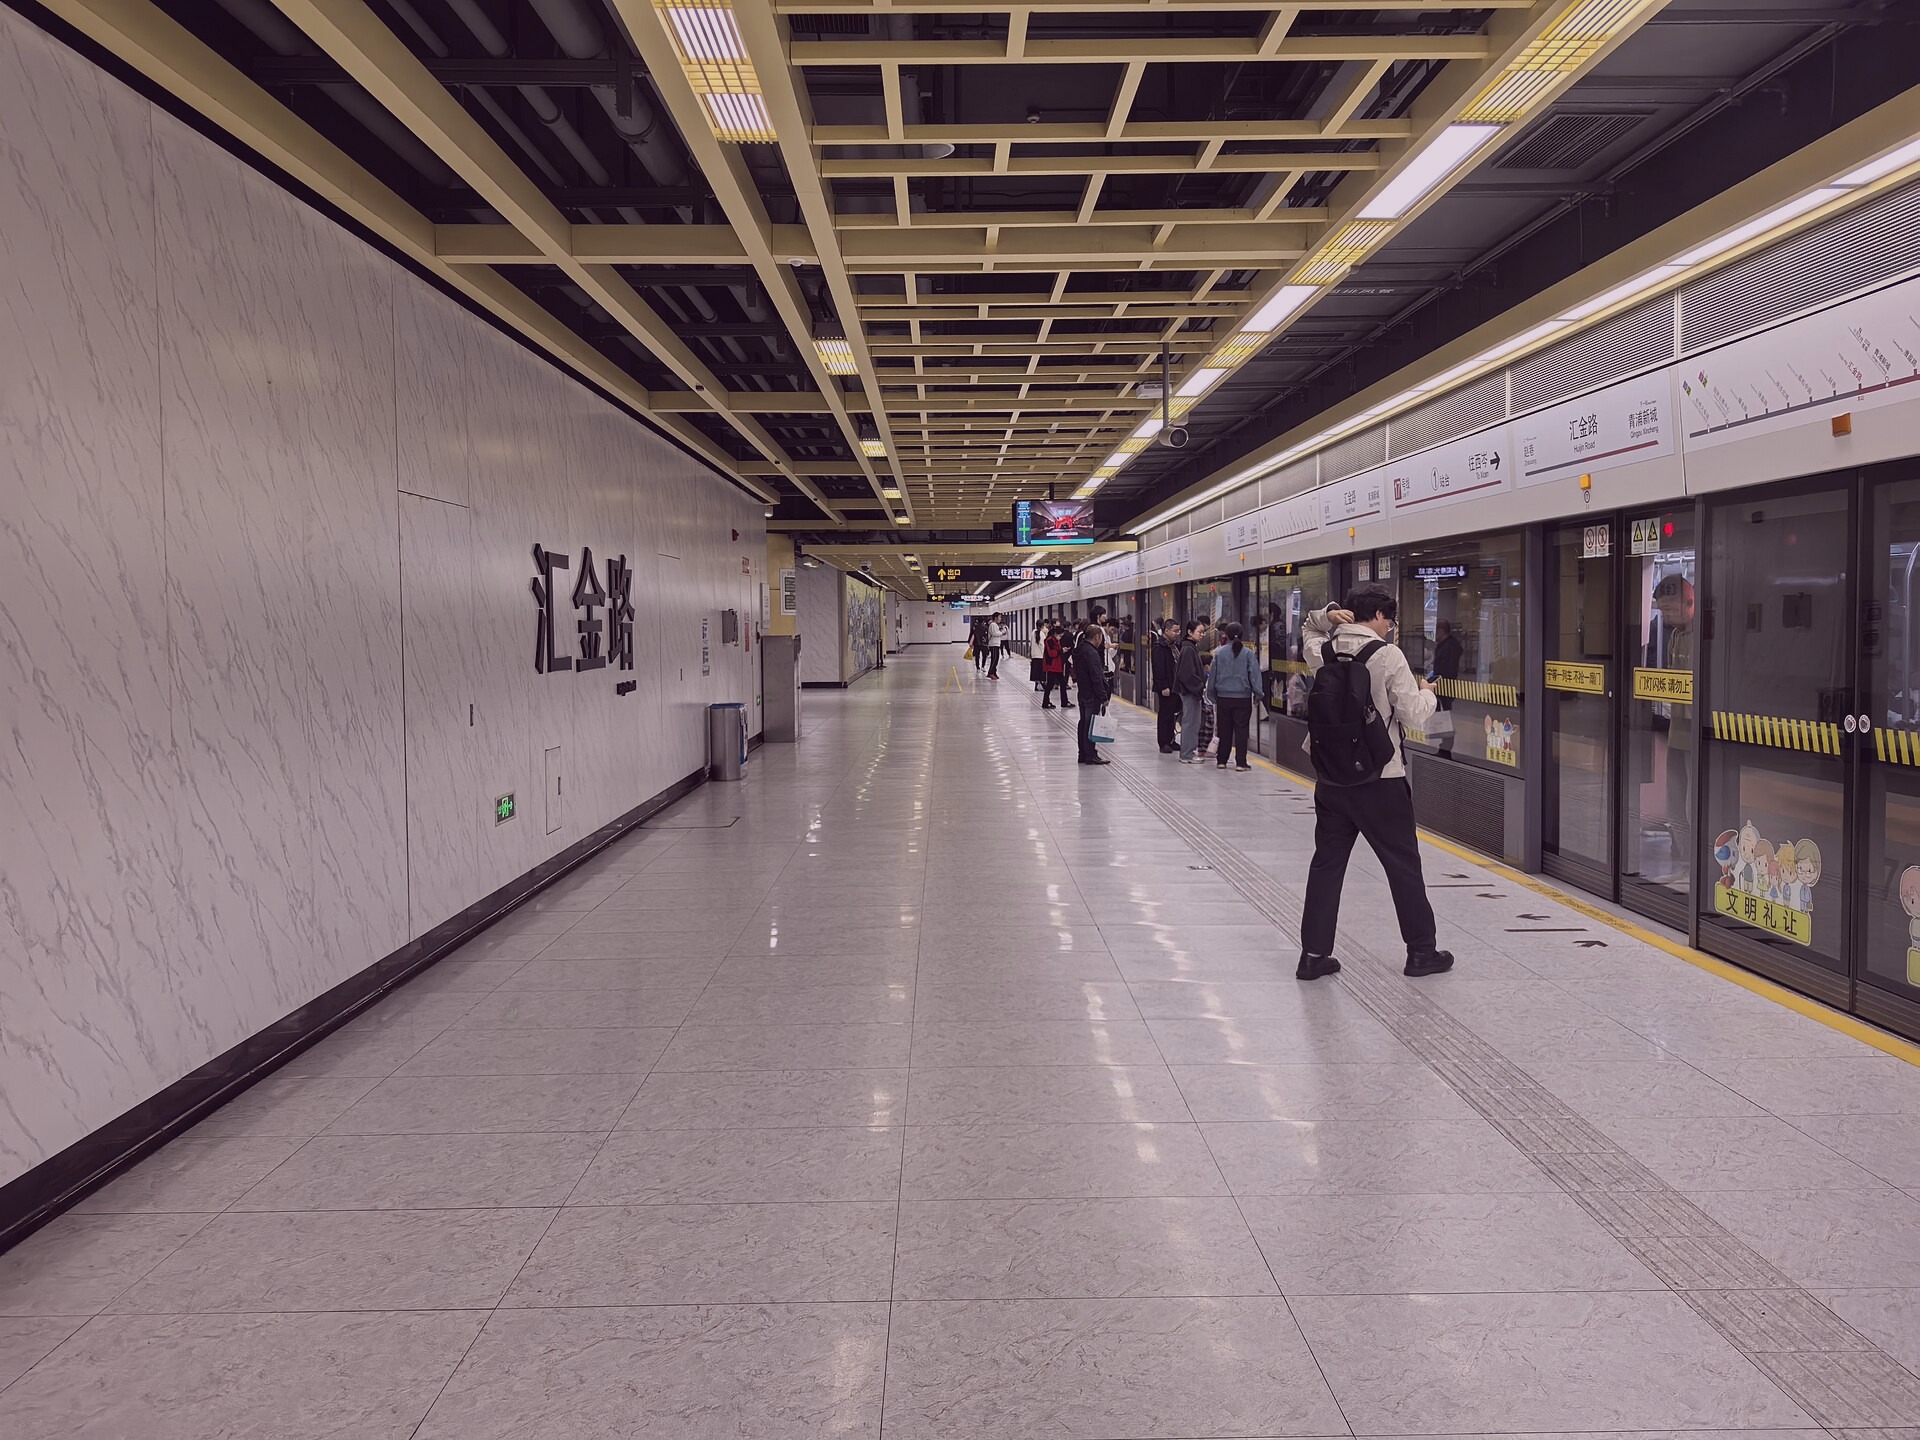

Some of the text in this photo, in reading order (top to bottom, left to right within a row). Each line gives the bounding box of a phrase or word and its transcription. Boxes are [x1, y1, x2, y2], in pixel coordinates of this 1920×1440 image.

[1569, 413, 1598, 441] 汇金路
[1628, 407, 1658, 429] 青浦新城
[1584, 441, 1596, 451] Road
[1469, 452, 1488, 472] 往西岑
[1395, 480, 1401, 499] 17
[1022, 568, 1033, 579] 17
[532, 543, 635, 674] 汇金路
[1639, 676, 1693, 694] 门灯闪烁 请勿上
[1726, 891, 1797, 936] 文明礼让
